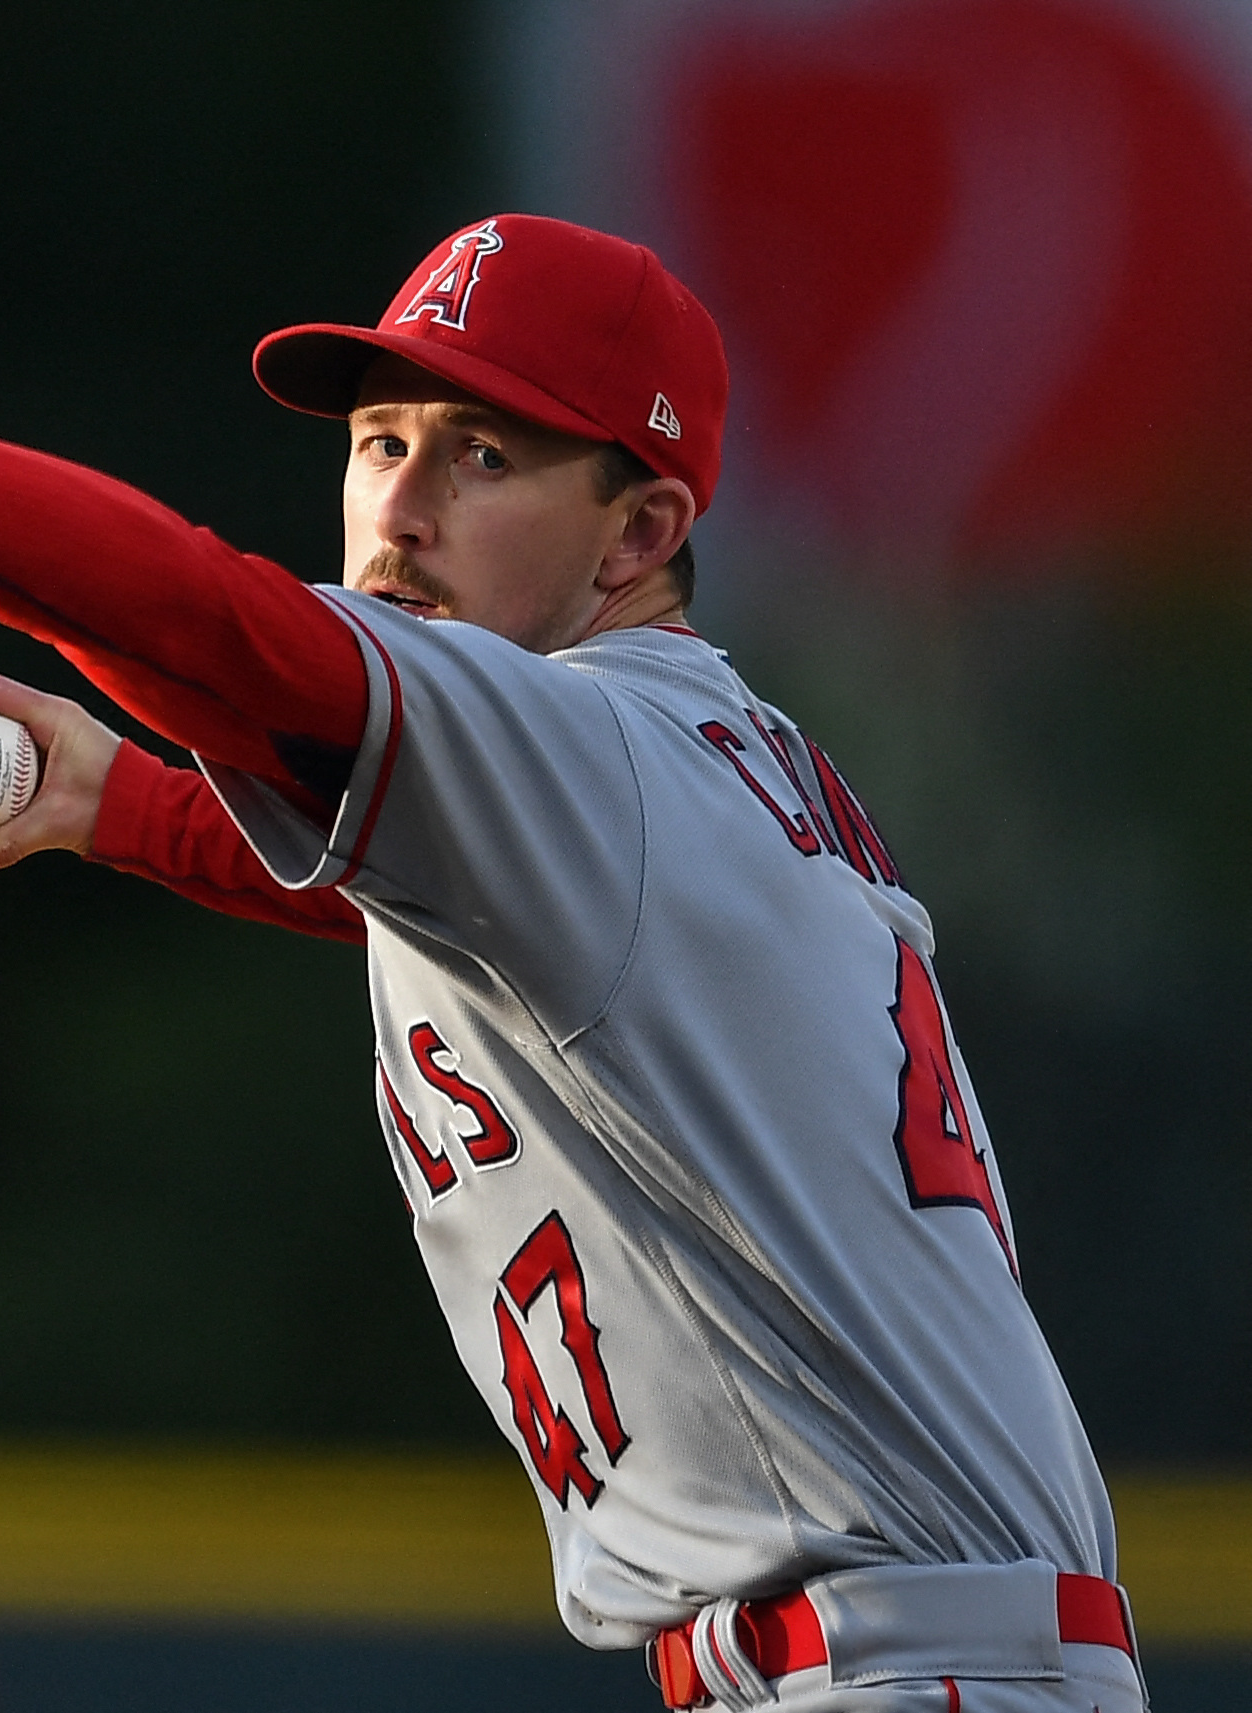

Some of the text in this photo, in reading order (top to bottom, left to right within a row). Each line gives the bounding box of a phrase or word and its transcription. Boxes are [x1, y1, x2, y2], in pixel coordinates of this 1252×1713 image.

[395, 219, 504, 331] A
[375, 1016, 523, 1208] LS
[493, 1208, 632, 1512] 47
